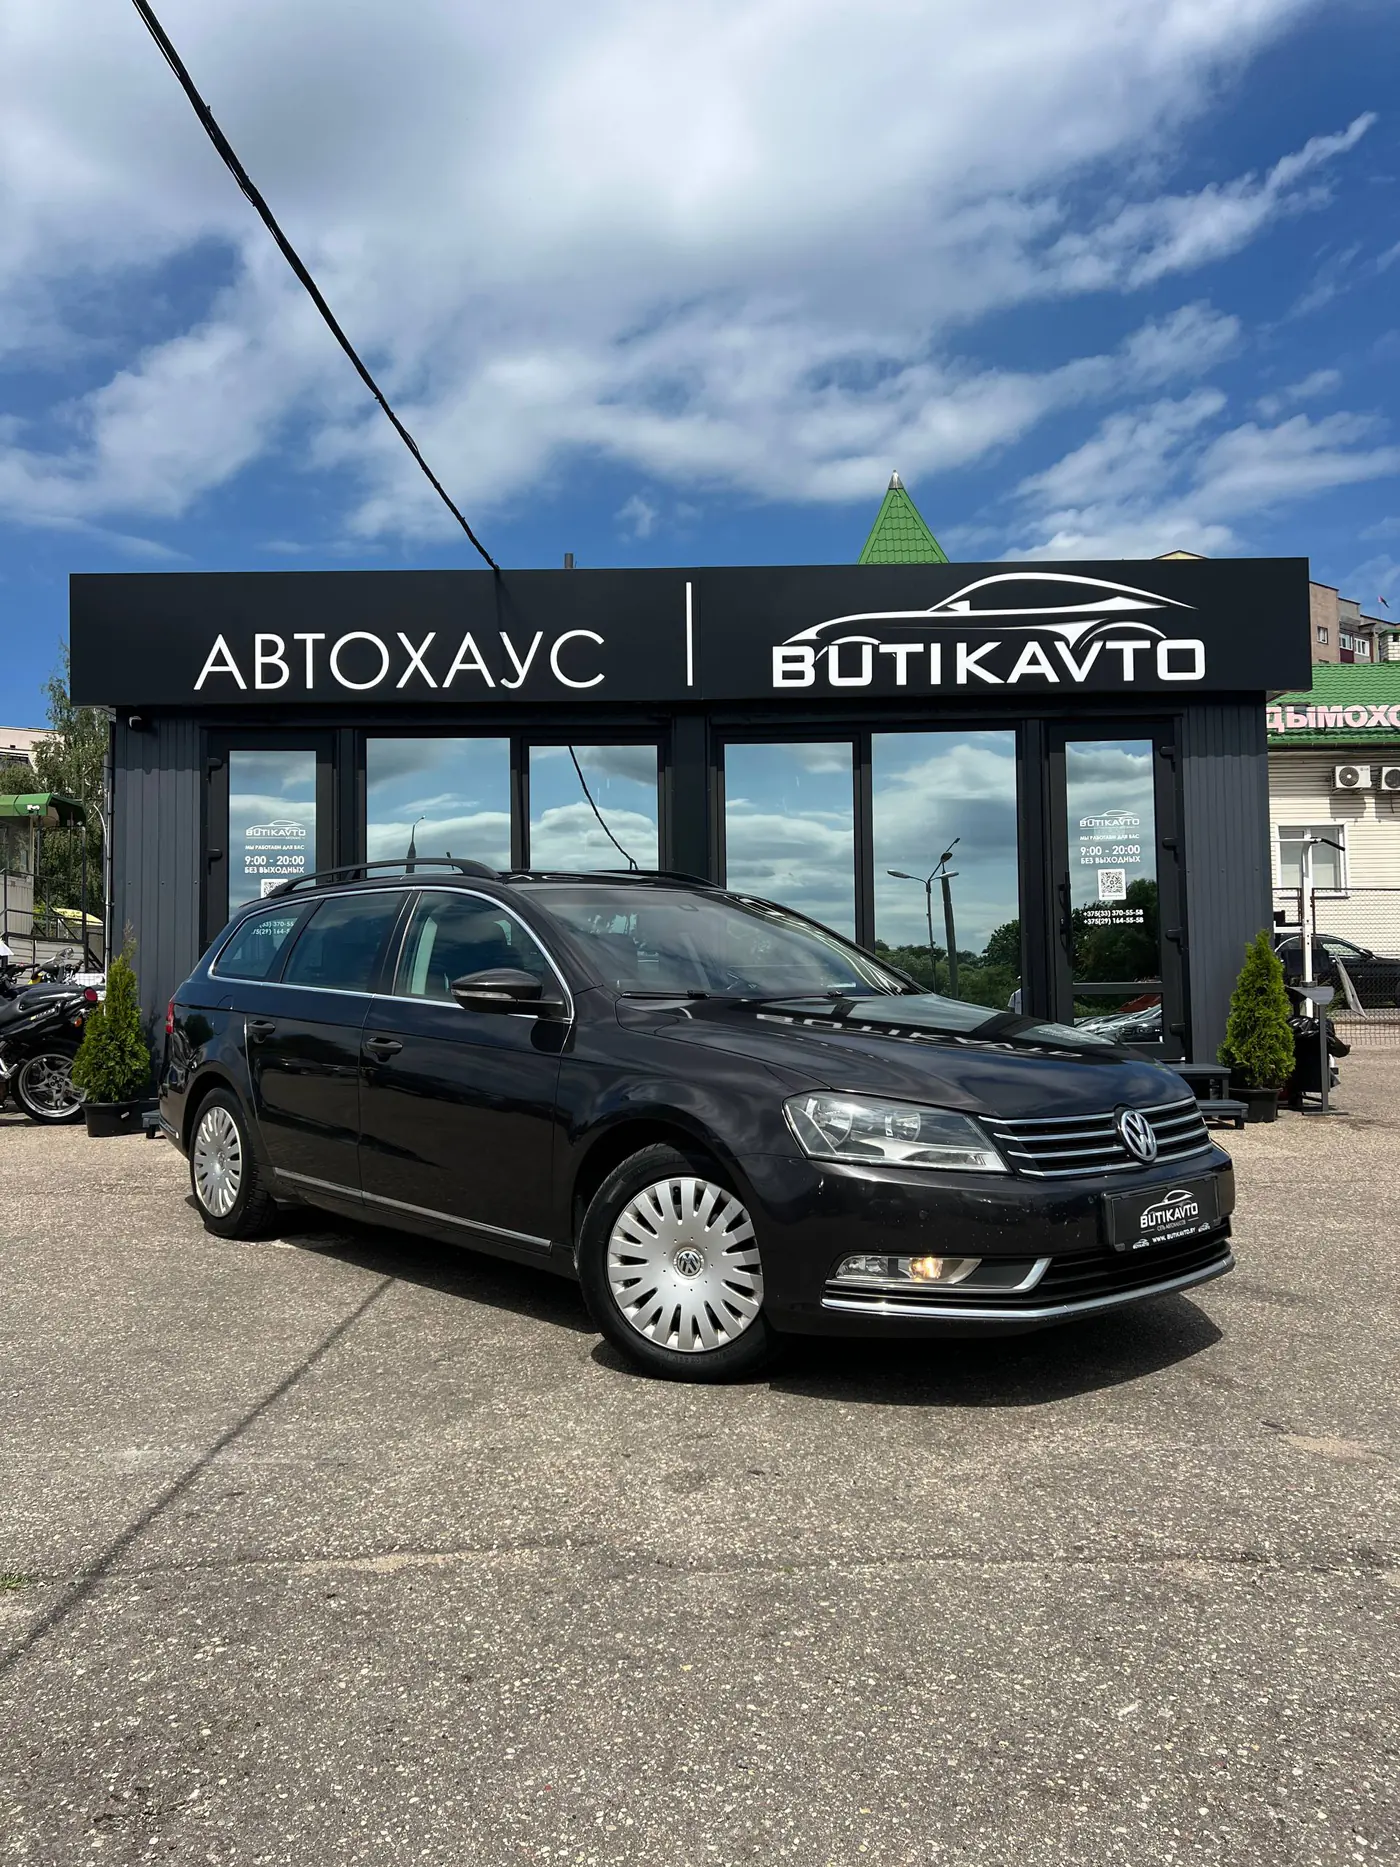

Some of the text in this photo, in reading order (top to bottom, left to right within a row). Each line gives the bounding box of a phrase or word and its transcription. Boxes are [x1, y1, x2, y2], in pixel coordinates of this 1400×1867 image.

[193, 629, 606, 690] АВТОХАУС
[772, 638, 1206, 688] BUTIKAVTO
[1080, 818, 1140, 827] BUTIKAVTO
[1080, 846, 1102, 856] 9:00
[1112, 845, 1140, 855] 20:00
[244, 855, 267, 865] 9:00
[276, 855, 305, 865] 20:00
[1080, 855, 1141, 865] БЕЗ ВЫХОДНЫХ
[244, 866, 305, 874] БЕЗ ВЫХОДНЫХ
[1083, 910, 1111, 918] +375(33)
[1083, 918, 1112, 926] +375(29)
[1140, 1202, 1199, 1229] BUTIKAVTO
